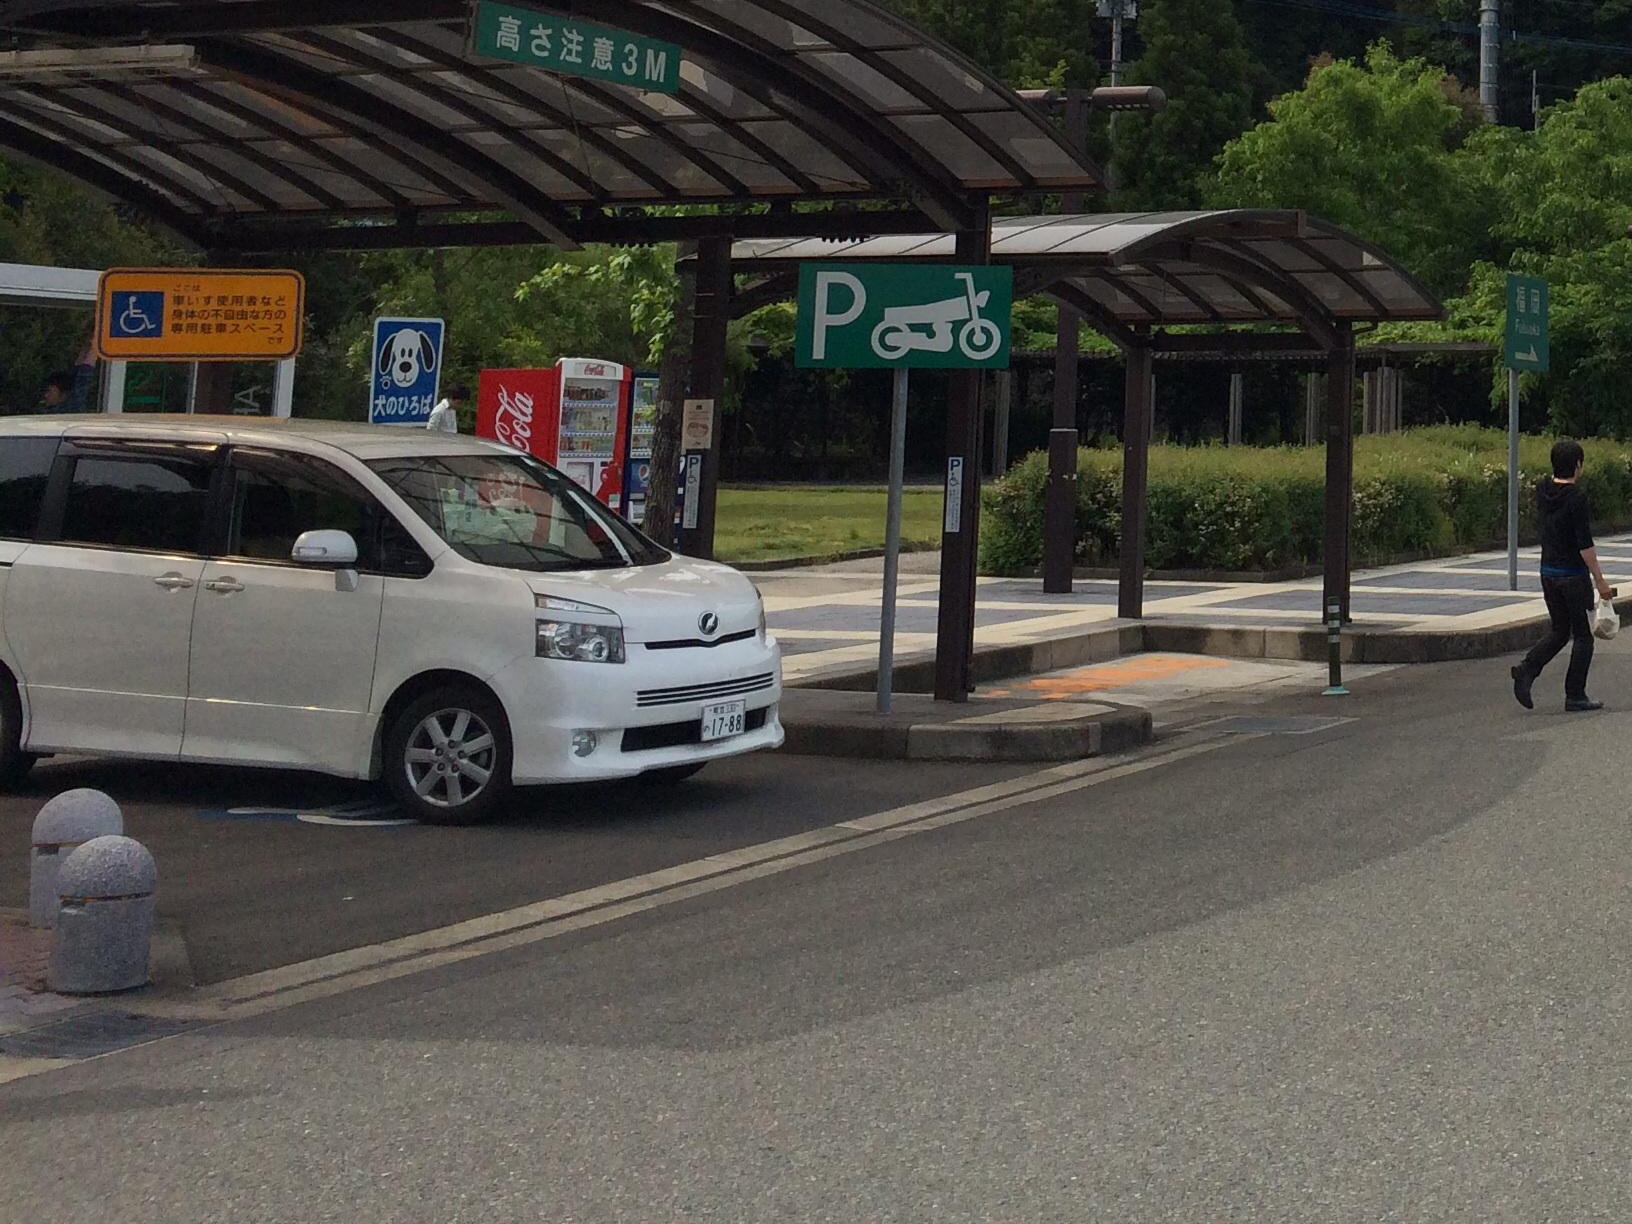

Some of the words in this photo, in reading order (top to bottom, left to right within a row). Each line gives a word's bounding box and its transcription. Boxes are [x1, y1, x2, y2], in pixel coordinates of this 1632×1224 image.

[496, 15, 667, 83] 高さ注意3M
[812, 271, 867, 360] P
[170, 322, 285, 335] 専用駐車スペース
[373, 393, 433, 418] 犬のひろば
[950, 459, 961, 471] P
[712, 714, 742, 737] 17-88
